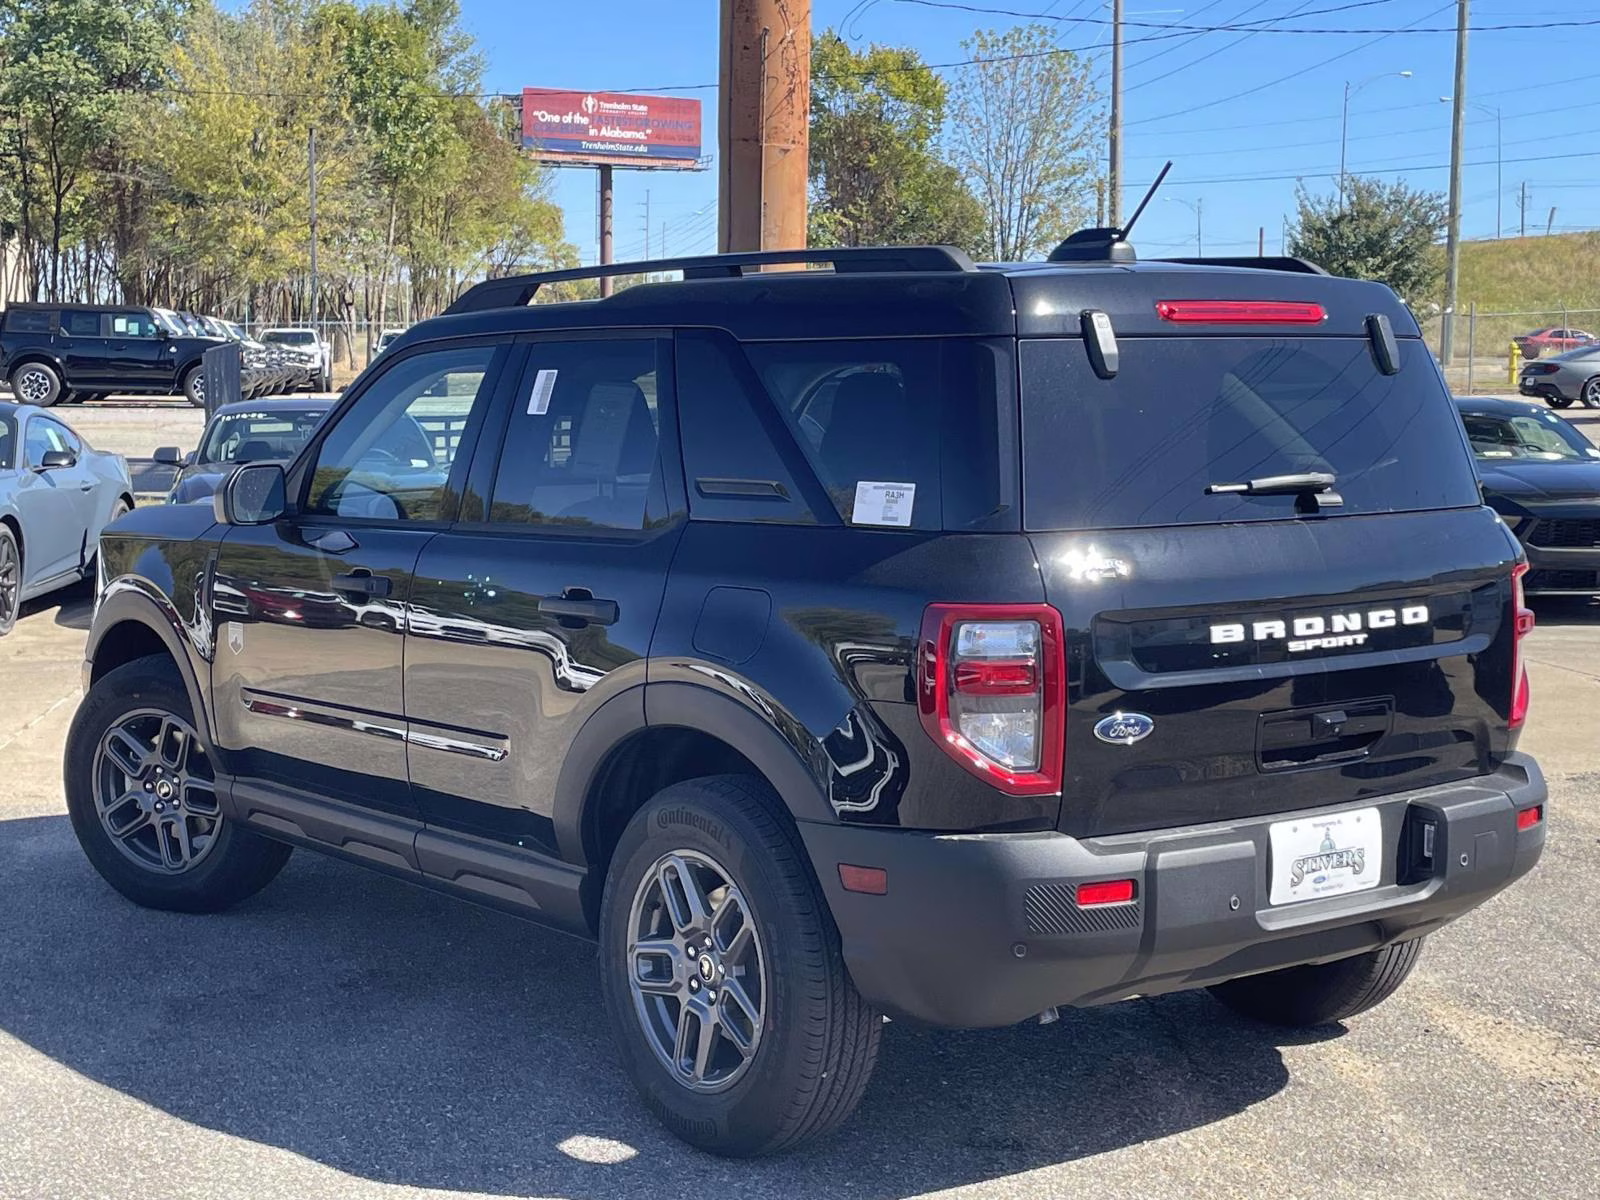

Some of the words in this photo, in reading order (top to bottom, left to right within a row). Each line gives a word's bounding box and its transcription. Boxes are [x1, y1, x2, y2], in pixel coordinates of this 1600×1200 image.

[562, 111, 573, 123] of
[573, 112, 589, 124] the
[589, 125, 598, 136] in
[1209, 605, 1429, 644] BRONCO
[1287, 633, 1369, 652] SPORT
[1109, 719, 1142, 738] Ford
[657, 806, 725, 842] Continental
[1290, 847, 1365, 888] STIVERS
